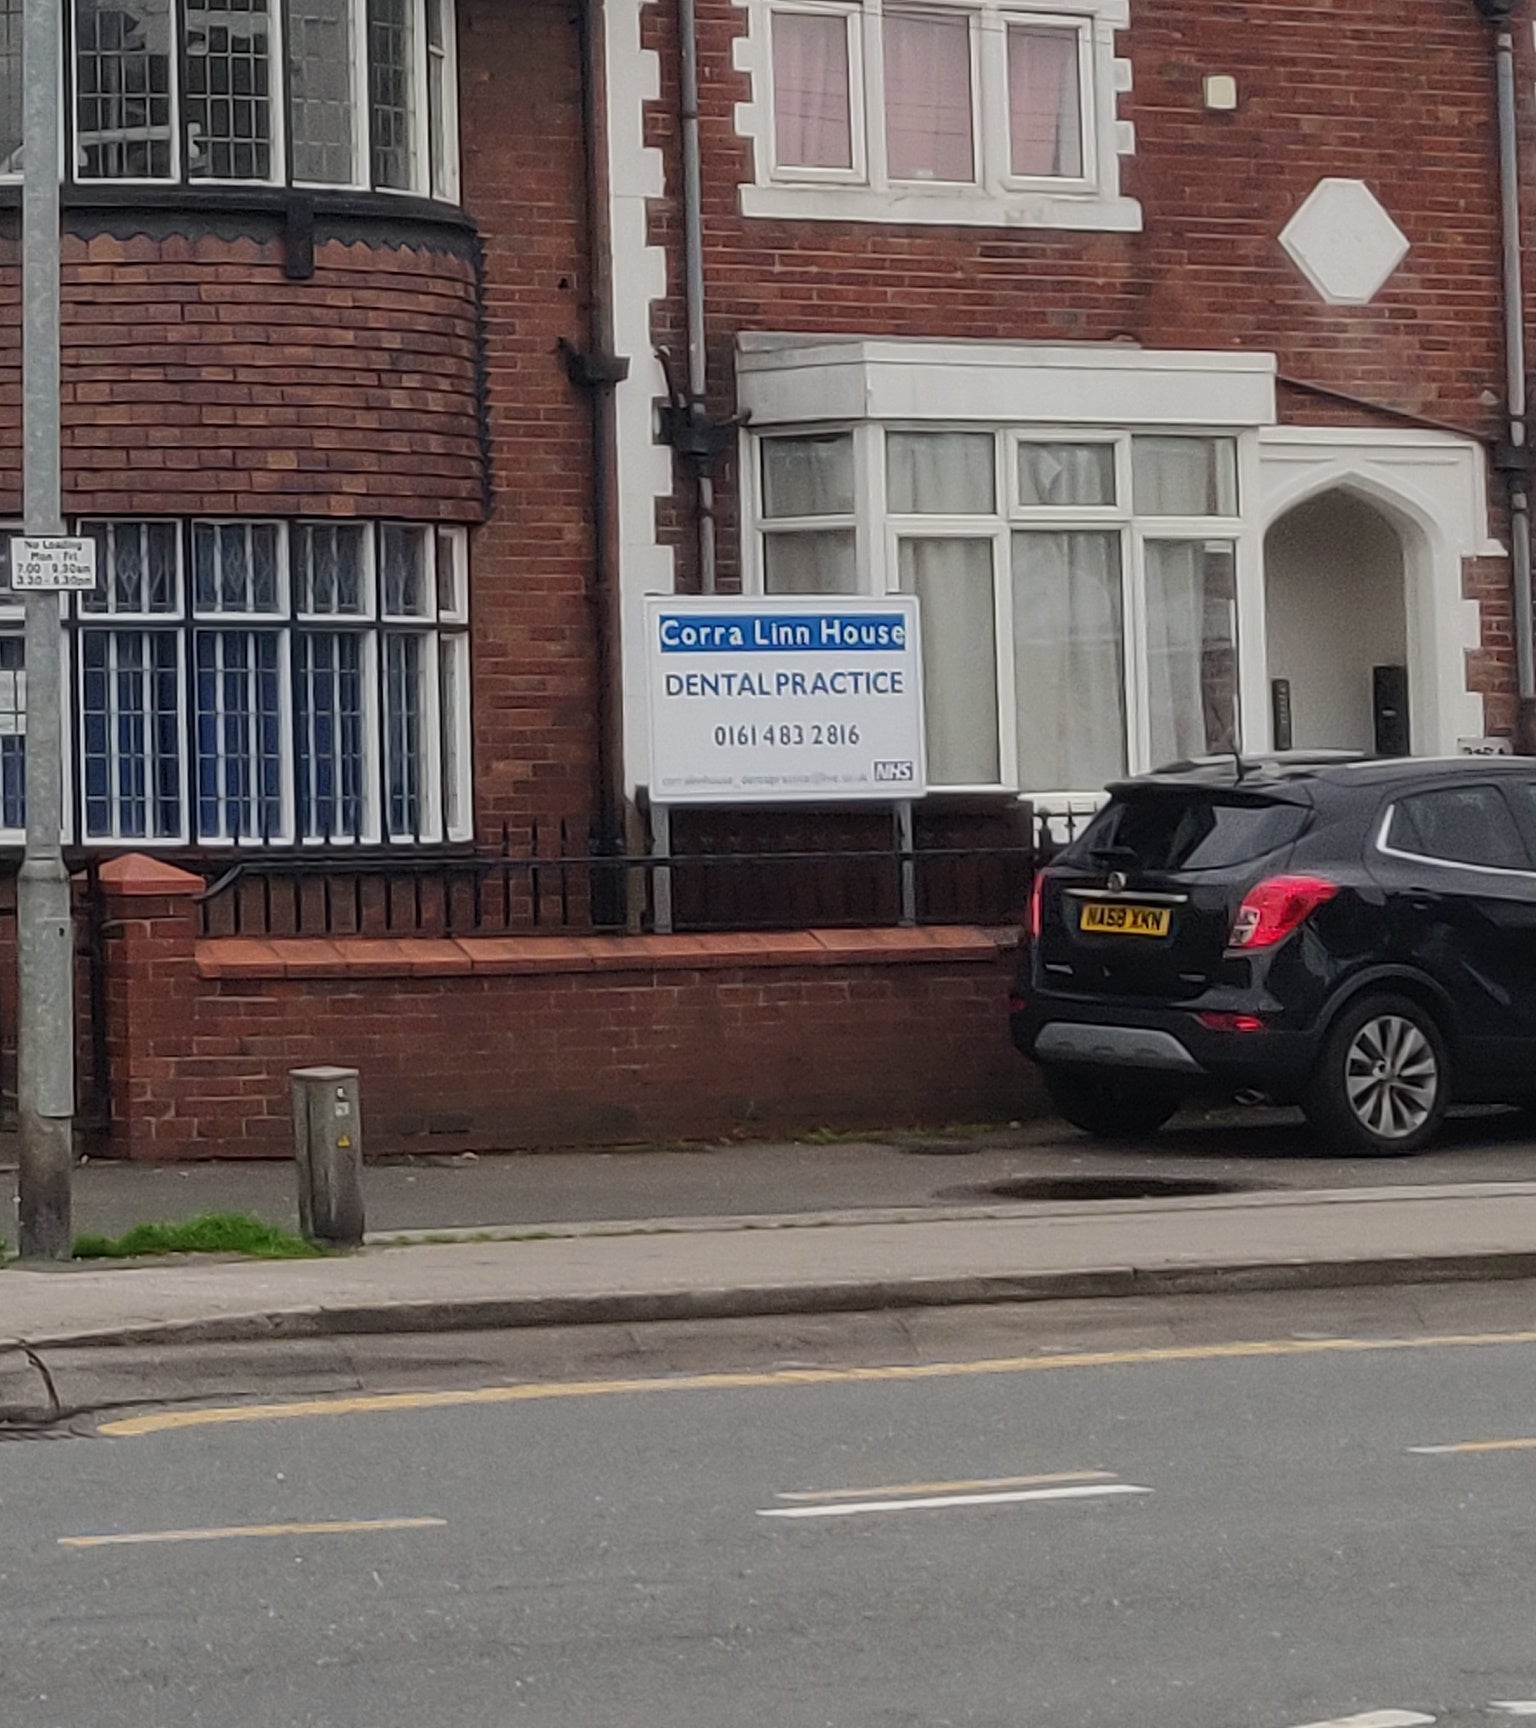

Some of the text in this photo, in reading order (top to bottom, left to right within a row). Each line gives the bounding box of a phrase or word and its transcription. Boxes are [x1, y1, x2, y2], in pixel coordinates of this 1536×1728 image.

[660, 619, 906, 646] Corra Linn House
[665, 671, 904, 696] DENTAL PRACTICE
[714, 724, 860, 746] 0161 483 2816
[875, 762, 912, 781] NHS
